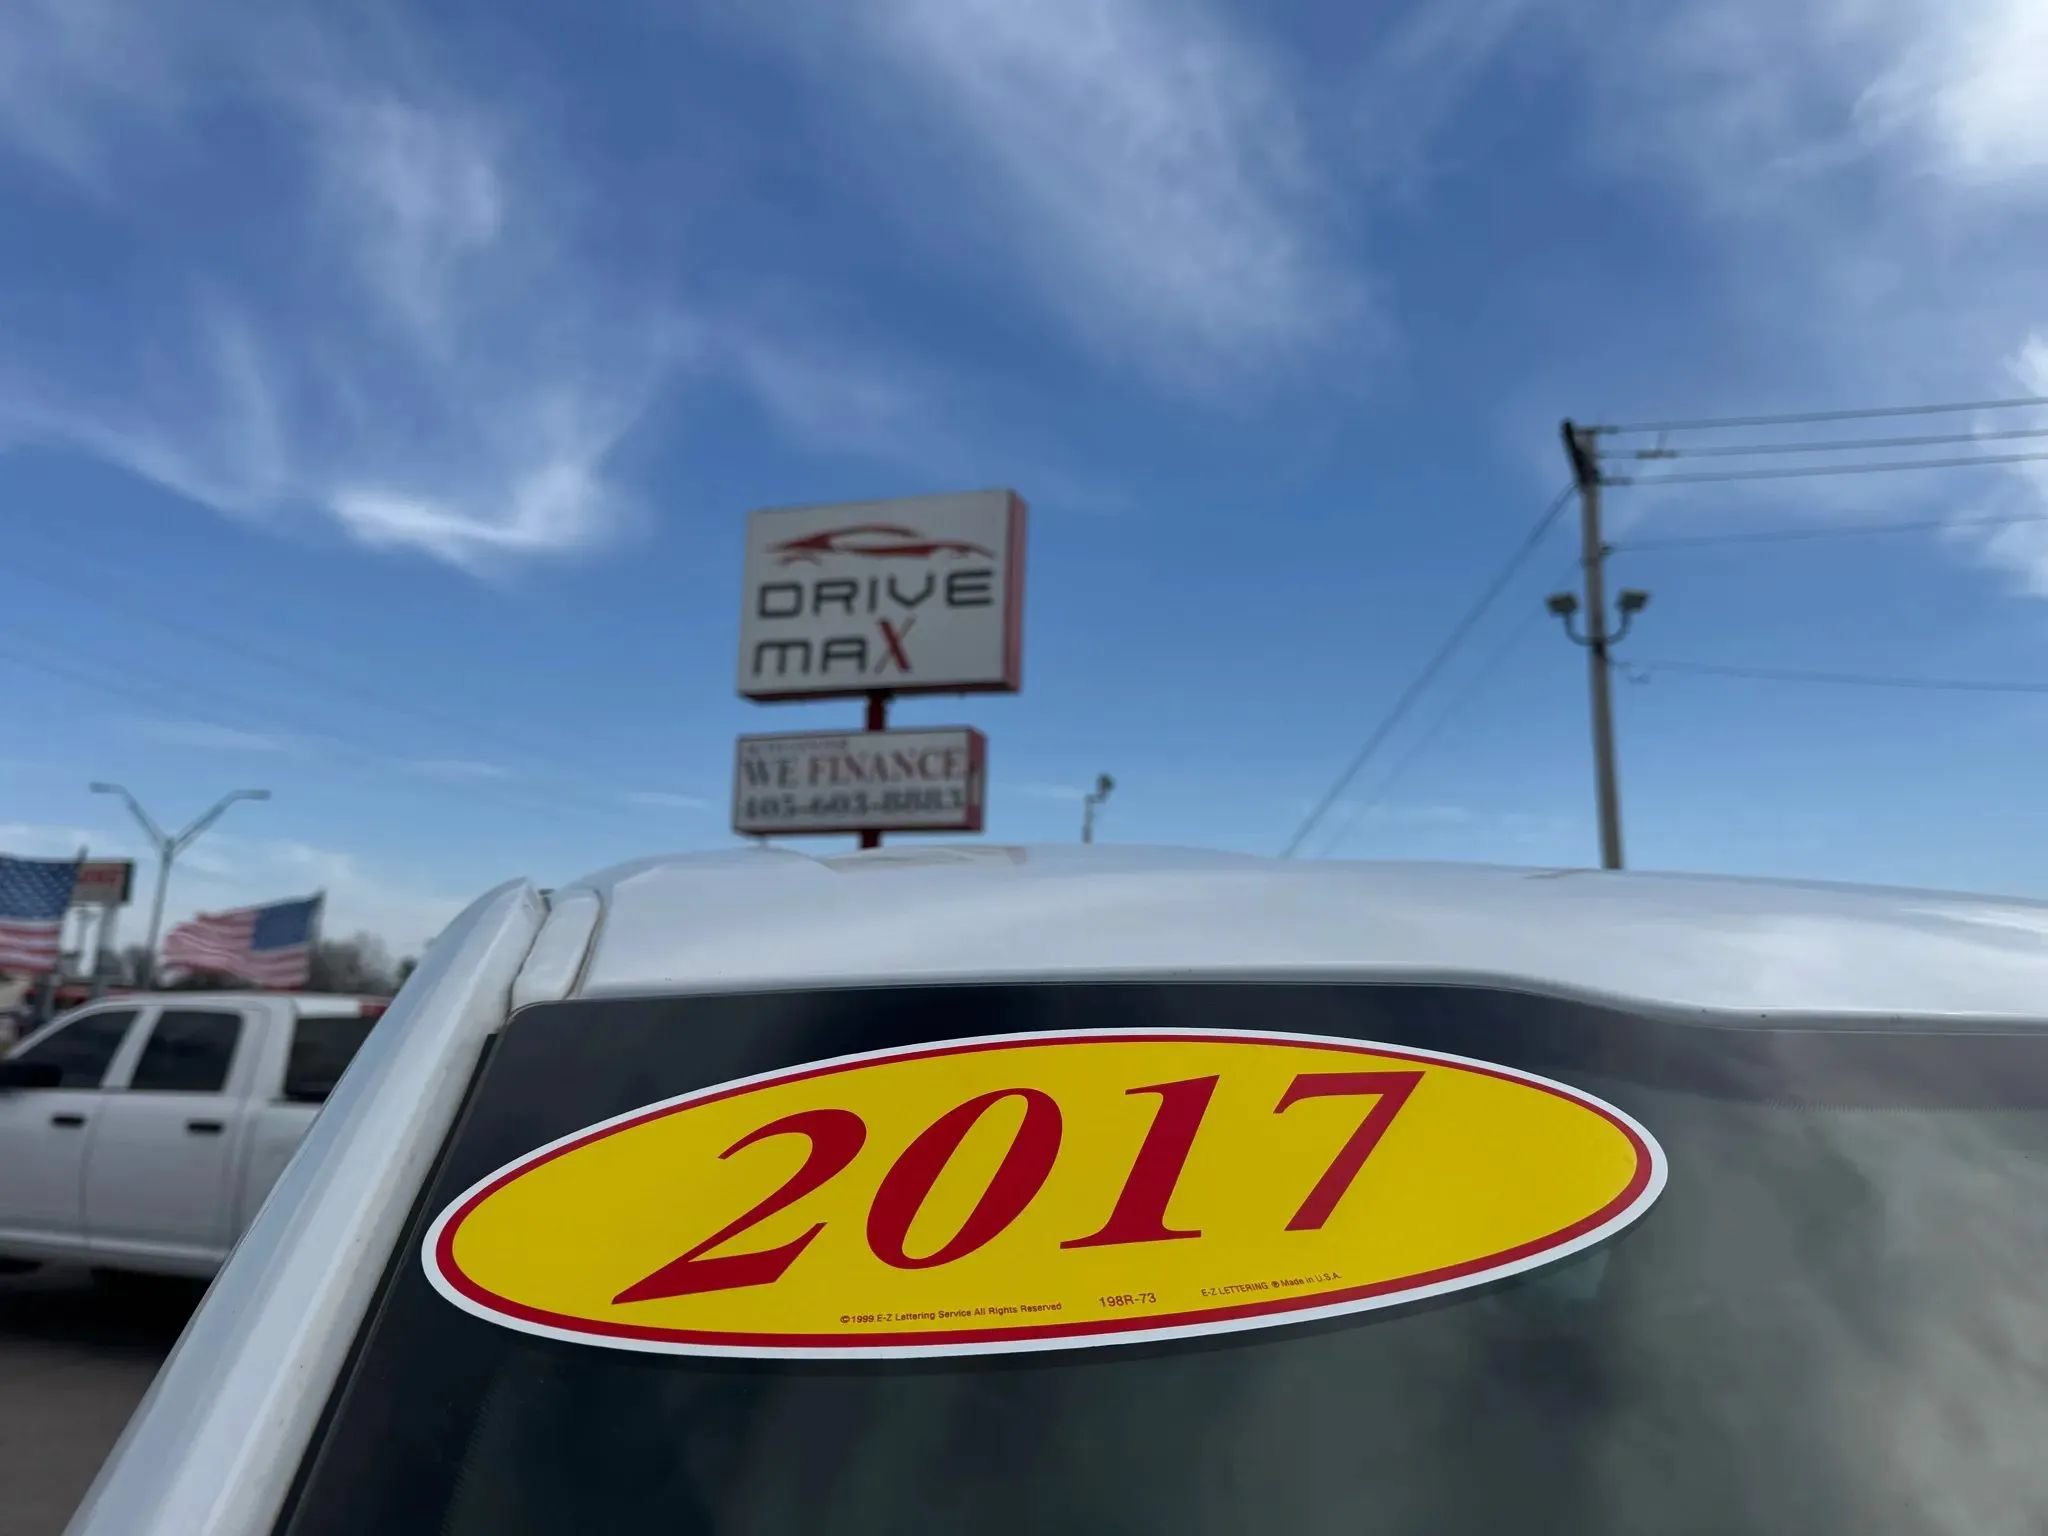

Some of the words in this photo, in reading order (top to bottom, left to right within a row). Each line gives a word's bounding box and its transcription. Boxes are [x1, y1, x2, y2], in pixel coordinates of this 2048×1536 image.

[758, 569, 994, 619] DRIVE
[745, 758, 800, 789] WE
[808, 747, 964, 786] FINANCE
[611, 1072, 1425, 1304] 2017
[1099, 1293, 1157, 1307] 198R-73
[1219, 1282, 1269, 1295] LETTERING
[895, 1312, 935, 1320] Lettering
[938, 1309, 971, 1319] Service
[974, 1308, 985, 1316] All
[988, 1306, 1018, 1315] Rights
[1020, 1302, 1062, 1313] Reserved
